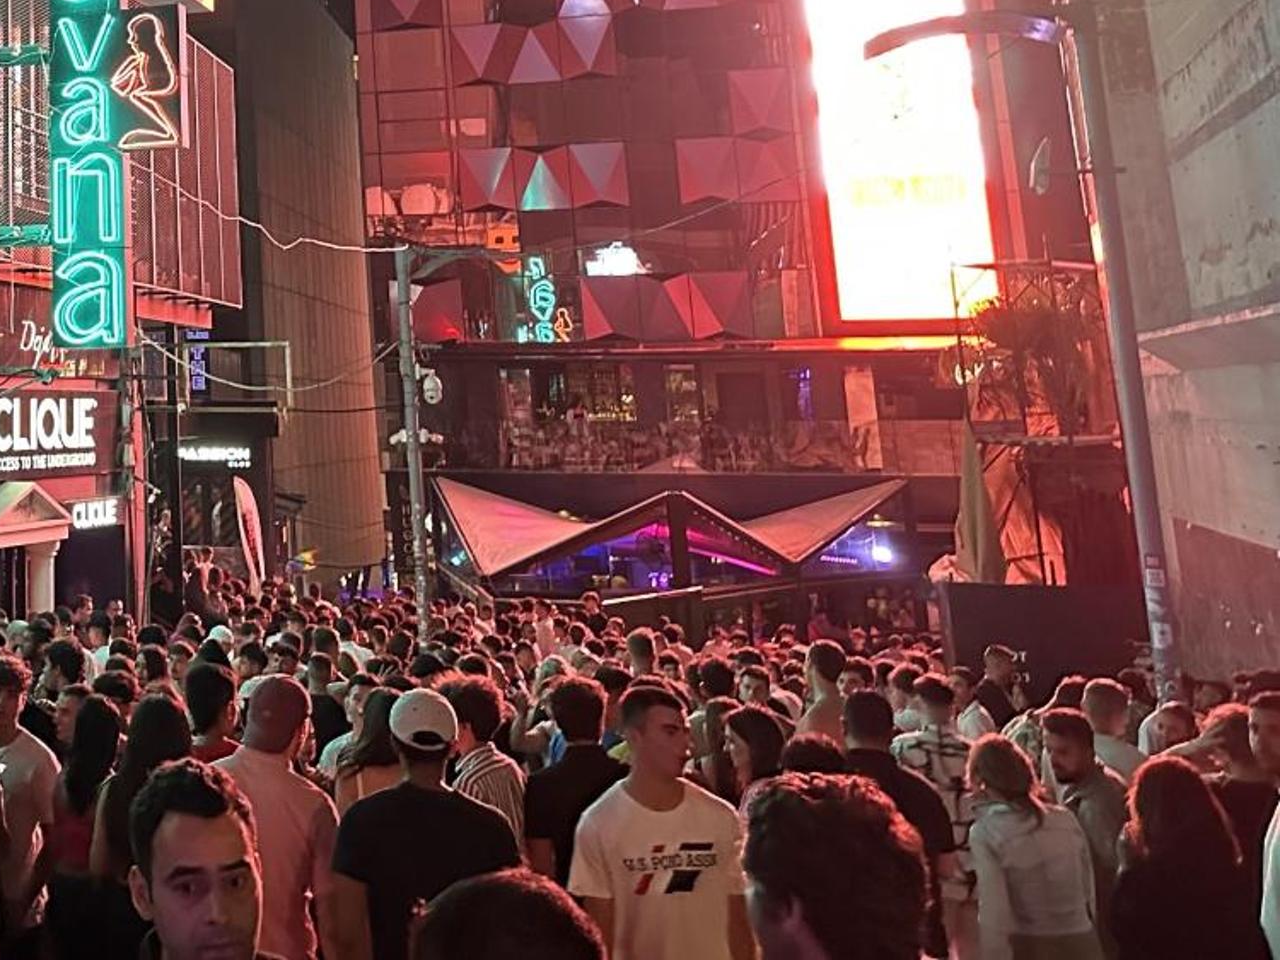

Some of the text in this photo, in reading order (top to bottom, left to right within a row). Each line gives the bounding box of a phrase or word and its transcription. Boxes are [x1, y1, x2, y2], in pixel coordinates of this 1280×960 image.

[21, 456, 31, 470] TO
[32, 454, 47, 470] THE
[72, 499, 118, 529] CLIQUE
